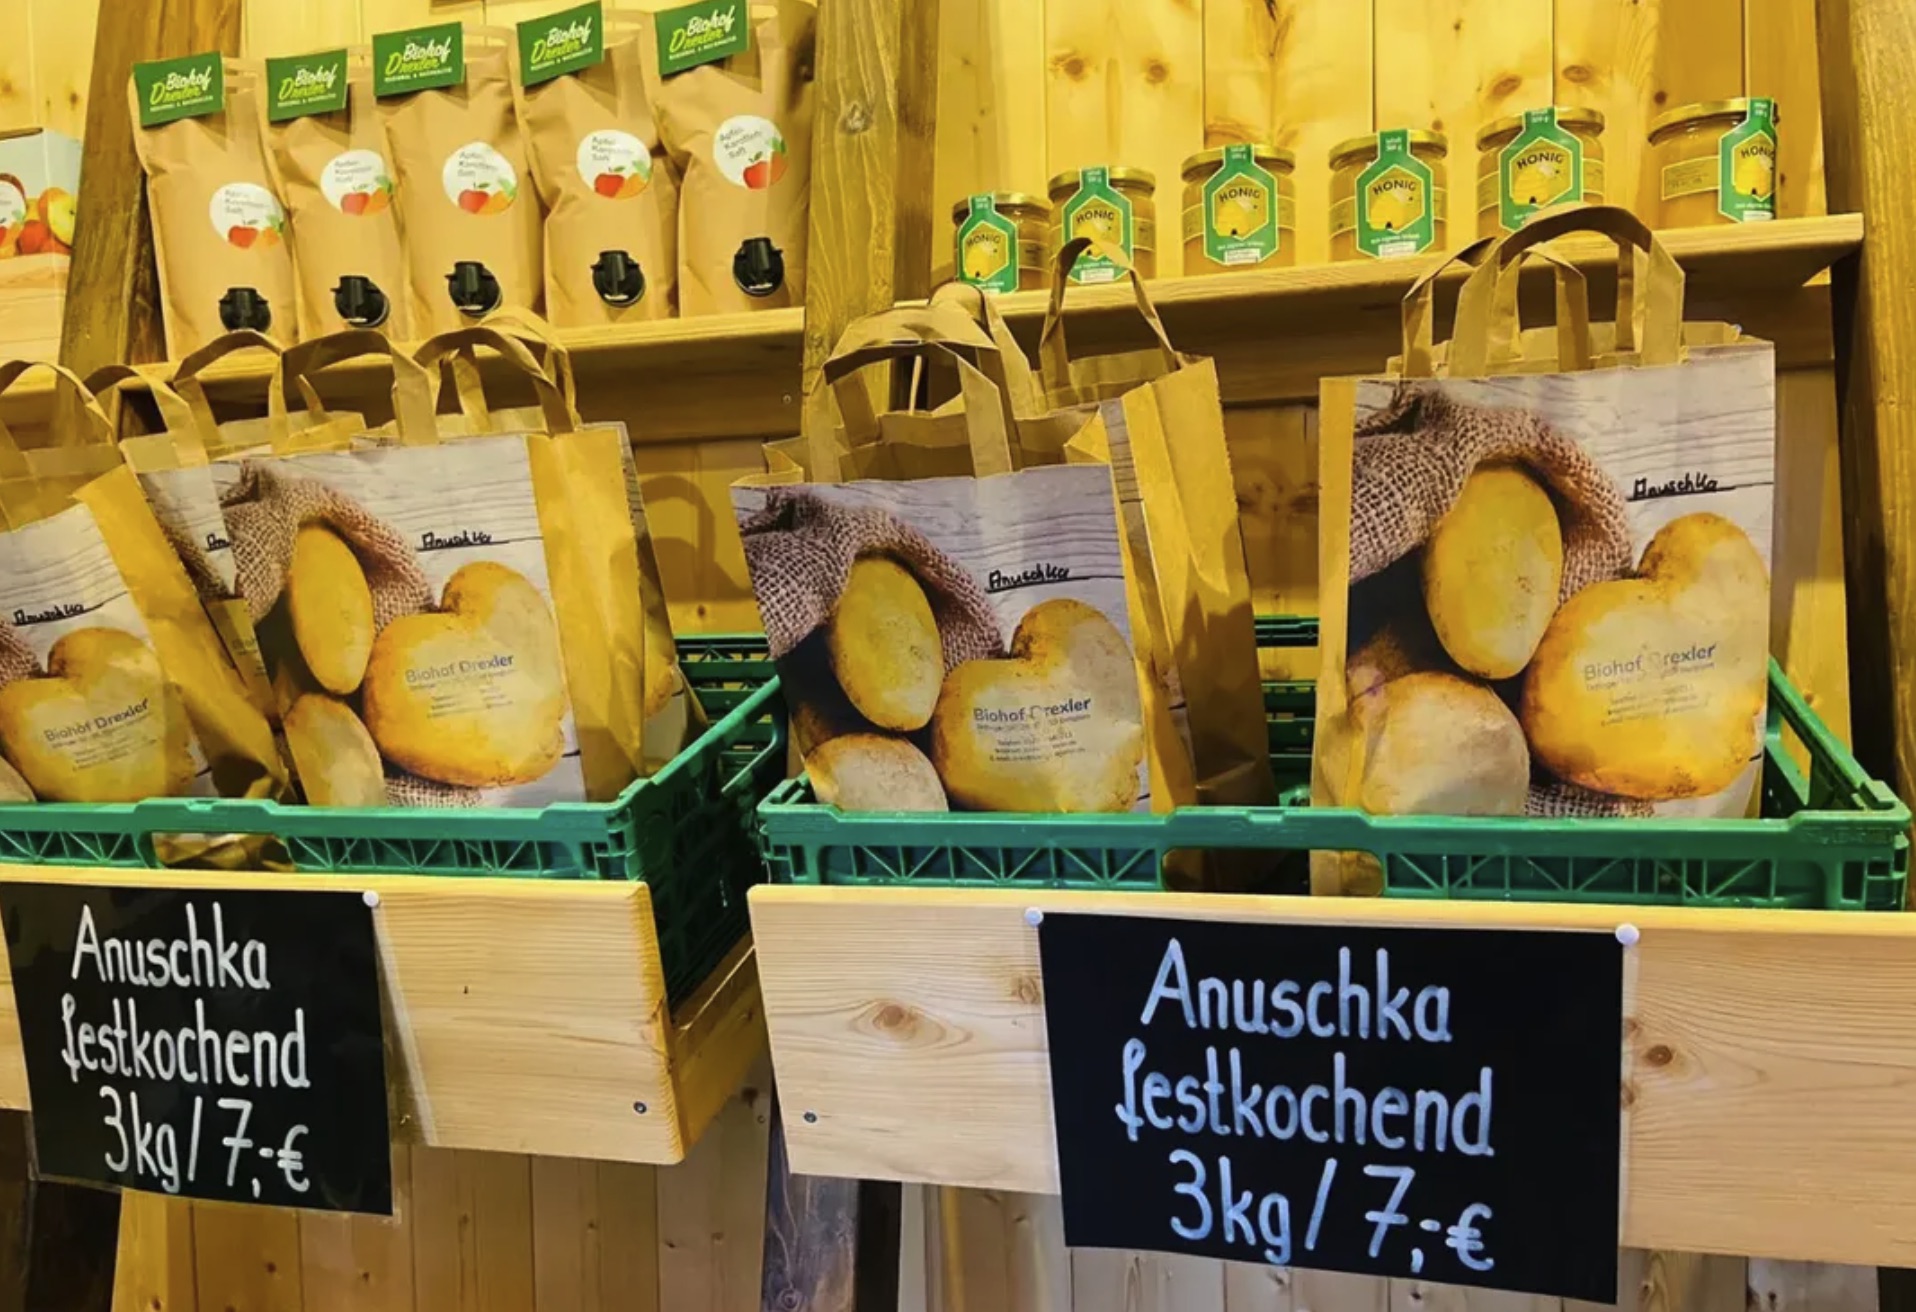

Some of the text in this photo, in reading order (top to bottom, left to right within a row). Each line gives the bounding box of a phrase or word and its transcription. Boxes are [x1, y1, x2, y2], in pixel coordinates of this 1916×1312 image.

[547, 16, 592, 48] Biohof
[685, 5, 735, 36] Biohof
[403, 36, 451, 62] Biohof
[166, 65, 212, 91] Biohof
[295, 63, 338, 88] Biohof
[1515, 152, 1563, 170] HONIG
[1219, 187, 1261, 203] HONIG
[1372, 180, 1417, 196] HONIG
[1076, 209, 1116, 224] HONIG
[967, 233, 1001, 247] HONIG
[1633, 473, 1719, 498] Anuschka
[988, 563, 1070, 590] Anuschka
[405, 663, 456, 683] Biohof
[458, 654, 514, 674] Drexler
[1584, 655, 1643, 681] Biohof
[44, 722, 92, 742] Biohof
[93, 697, 149, 730] Drexler
[973, 707, 1026, 722] Biohof
[71, 901, 271, 989] Anuschka
[1140, 938, 1453, 1042] Anuschka
[61, 993, 311, 1088] festkochend
[1115, 1038, 1495, 1157] festkochend
